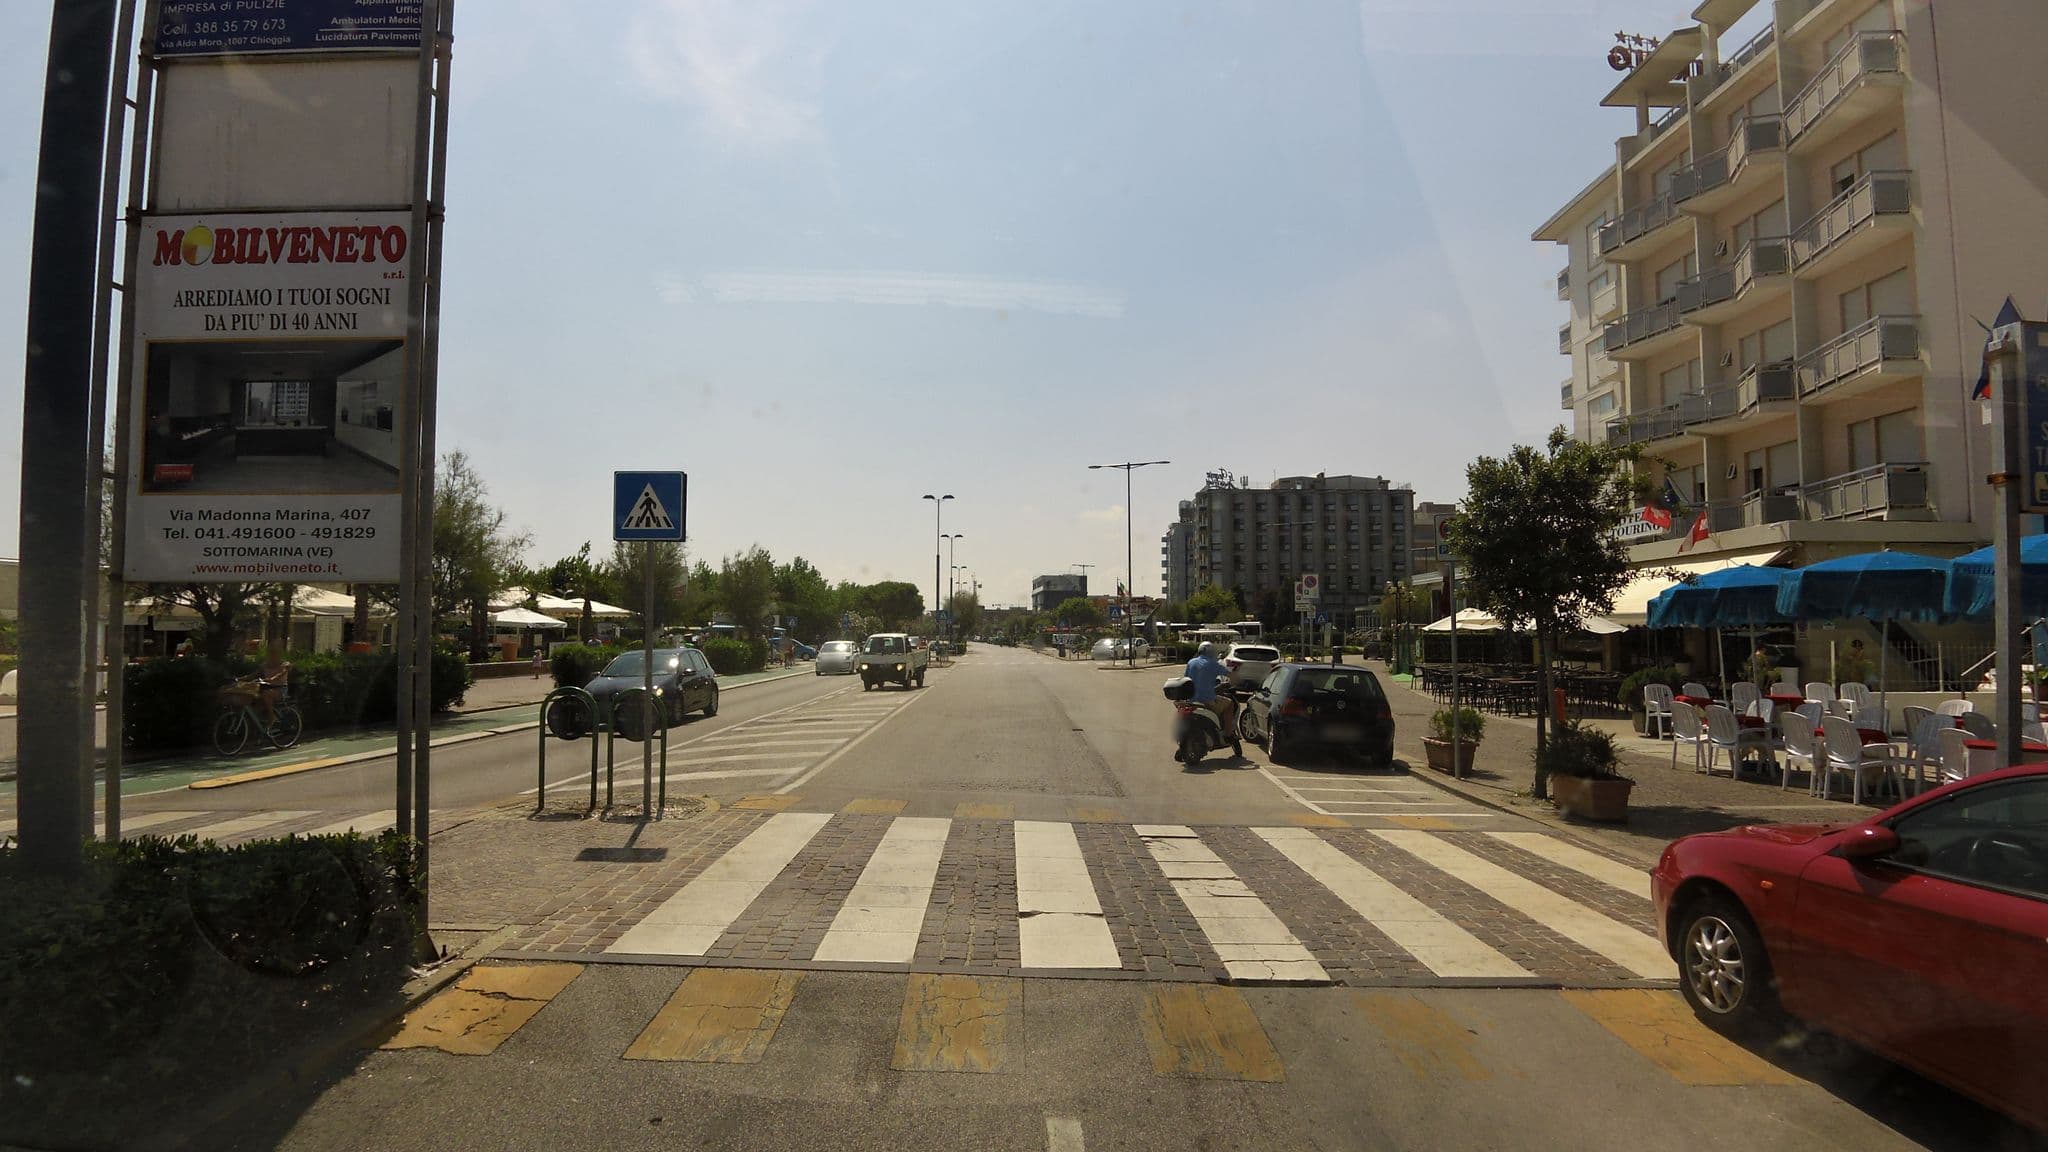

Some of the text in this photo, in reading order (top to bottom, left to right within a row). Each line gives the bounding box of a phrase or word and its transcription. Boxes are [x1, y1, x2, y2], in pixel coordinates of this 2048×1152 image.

[164, 0, 286, 14] IMPRESA di PULIZIE
[395, 6, 422, 14] Uffici
[194, 21, 218, 34] 388
[222, 20, 239, 32] 35
[243, 19, 257, 31] 79
[262, 18, 286, 31] 673
[331, 16, 422, 25] Ambulatori Medici
[176, 40, 196, 48] Aldo
[250, 35, 291, 46] Chioggia
[315, 32, 368, 41] Lucidatura
[153, 225, 407, 266] MOBILVENETO
[173, 287, 391, 308] ARREDIAMO I TUOI SOGNI
[204, 313, 227, 331] DA
[270, 313, 288, 330] DI
[292, 313, 309, 330] 40
[314, 312, 358, 330] ANNI
[169, 509, 371, 522] Via Madonna Marina, 407
[162, 527, 190, 539] Tel.
[194, 527, 296, 539] 041.491600
[310, 526, 376, 539] 491829
[203, 546, 333, 558] SOTTOMARINA (VE)
[196, 562, 338, 576] www.mobilveneto.it
